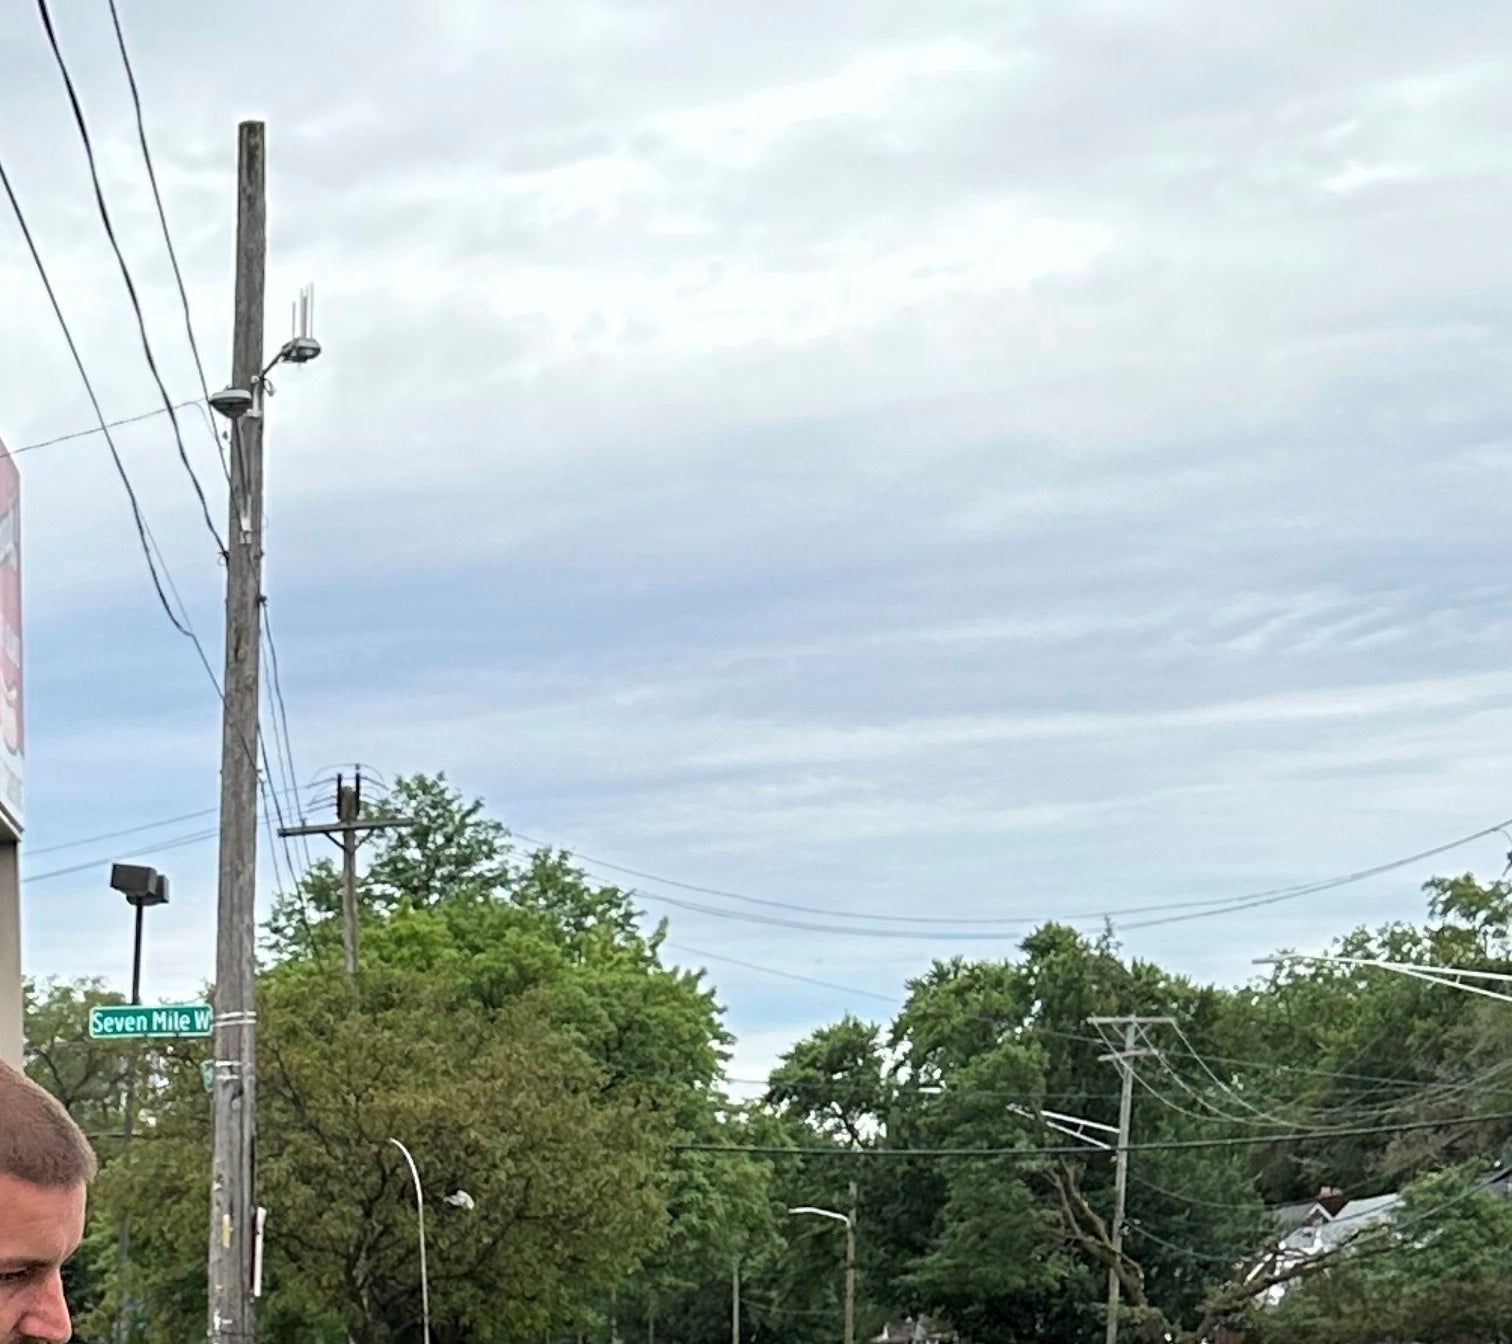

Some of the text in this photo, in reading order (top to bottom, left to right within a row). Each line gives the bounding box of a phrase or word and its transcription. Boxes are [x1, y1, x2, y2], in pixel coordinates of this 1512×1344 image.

[93, 1010, 209, 1033] Seven Mile W
